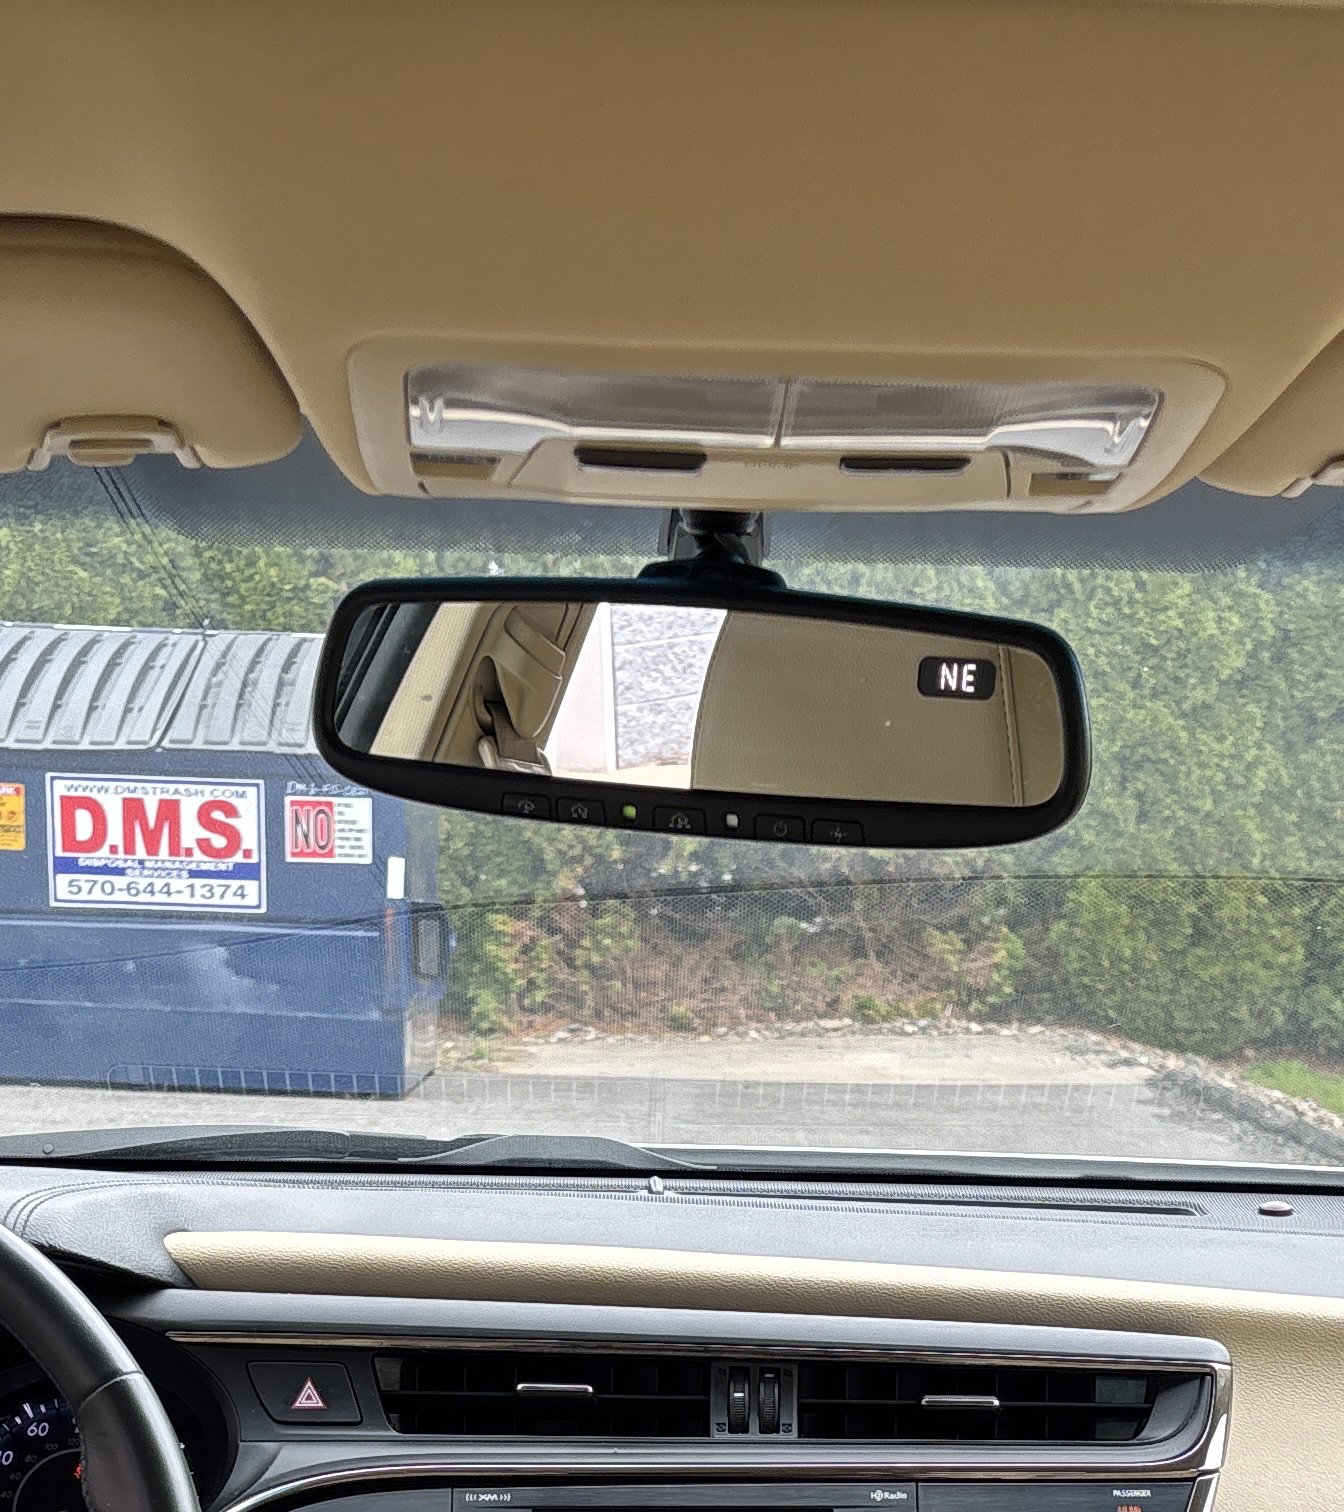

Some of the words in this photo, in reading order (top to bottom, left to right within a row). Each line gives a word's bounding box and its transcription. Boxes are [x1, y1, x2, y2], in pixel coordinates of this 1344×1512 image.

[939, 665, 977, 693] NE
[59, 795, 253, 859] D.M.S.
[290, 806, 333, 855] NO
[67, 878, 249, 901] 570-644-1374
[27, 1422, 49, 1437] 60
[1112, 1490, 1152, 1498] PASSENGER
